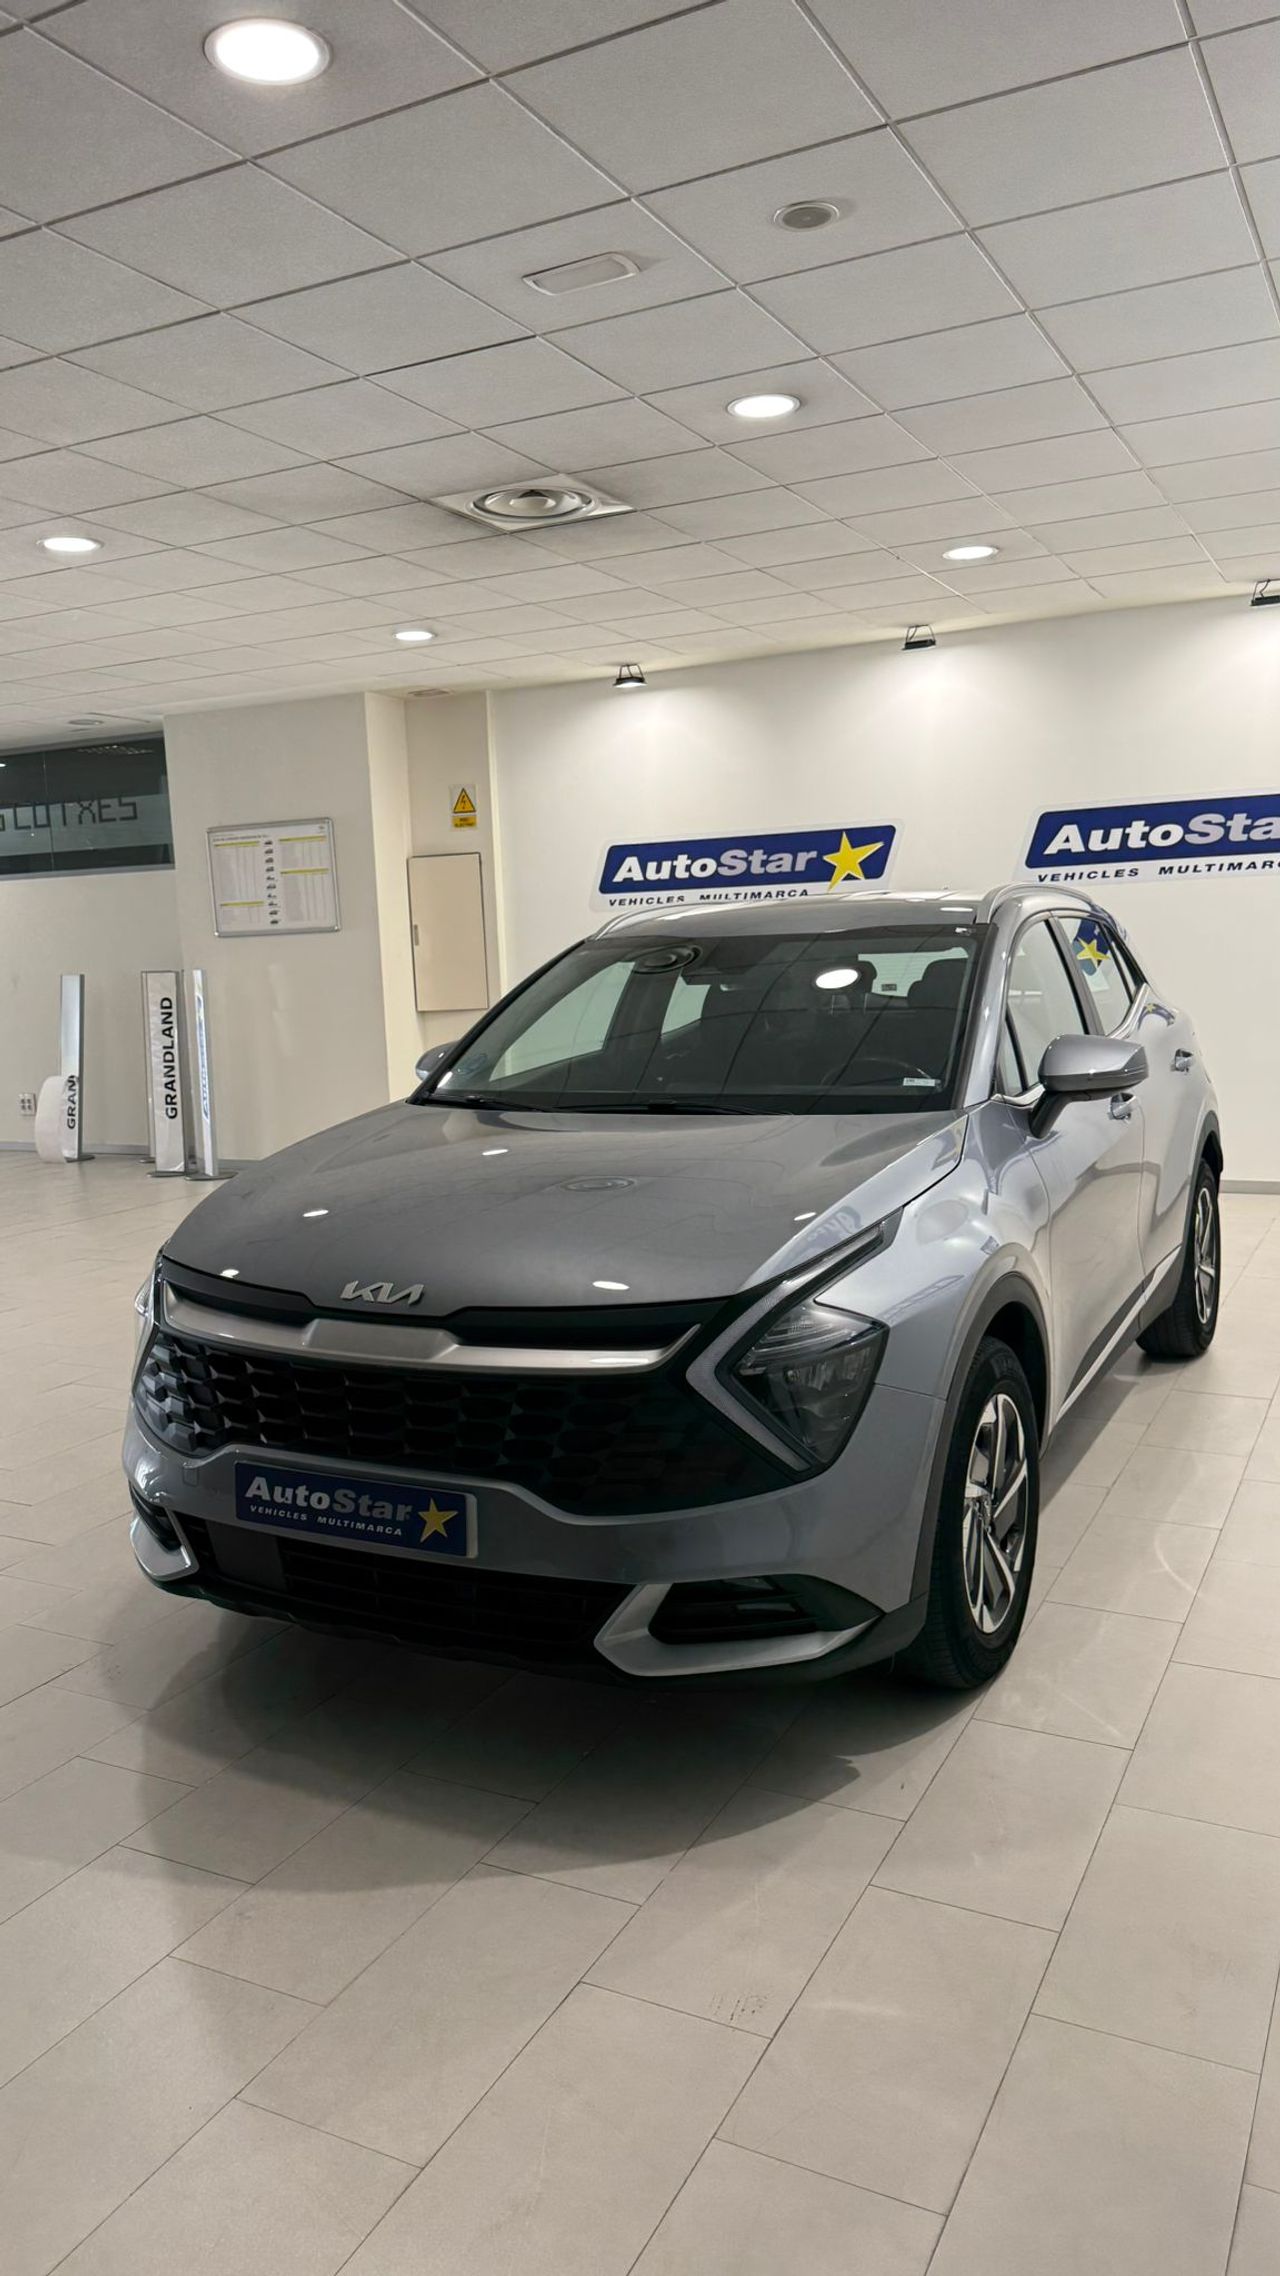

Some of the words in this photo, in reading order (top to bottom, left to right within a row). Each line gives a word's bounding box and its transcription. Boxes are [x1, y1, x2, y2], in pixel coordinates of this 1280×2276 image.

[612, 849, 817, 882] AutoStar
[1038, 868, 1139, 882] VEHICLES
[1158, 860, 1280, 875] MULTIMAR
[608, 895, 685, 906] VEHICLES
[699, 889, 808, 900] MULTIMARCA
[160, 997, 178, 1120] GRANDLAND
[340, 1281, 424, 1304] KIA
[246, 1476, 412, 1521] AutoStar
[251, 1505, 307, 1521] VEHICLES
[317, 1516, 402, 1536] MULTIMARCA
